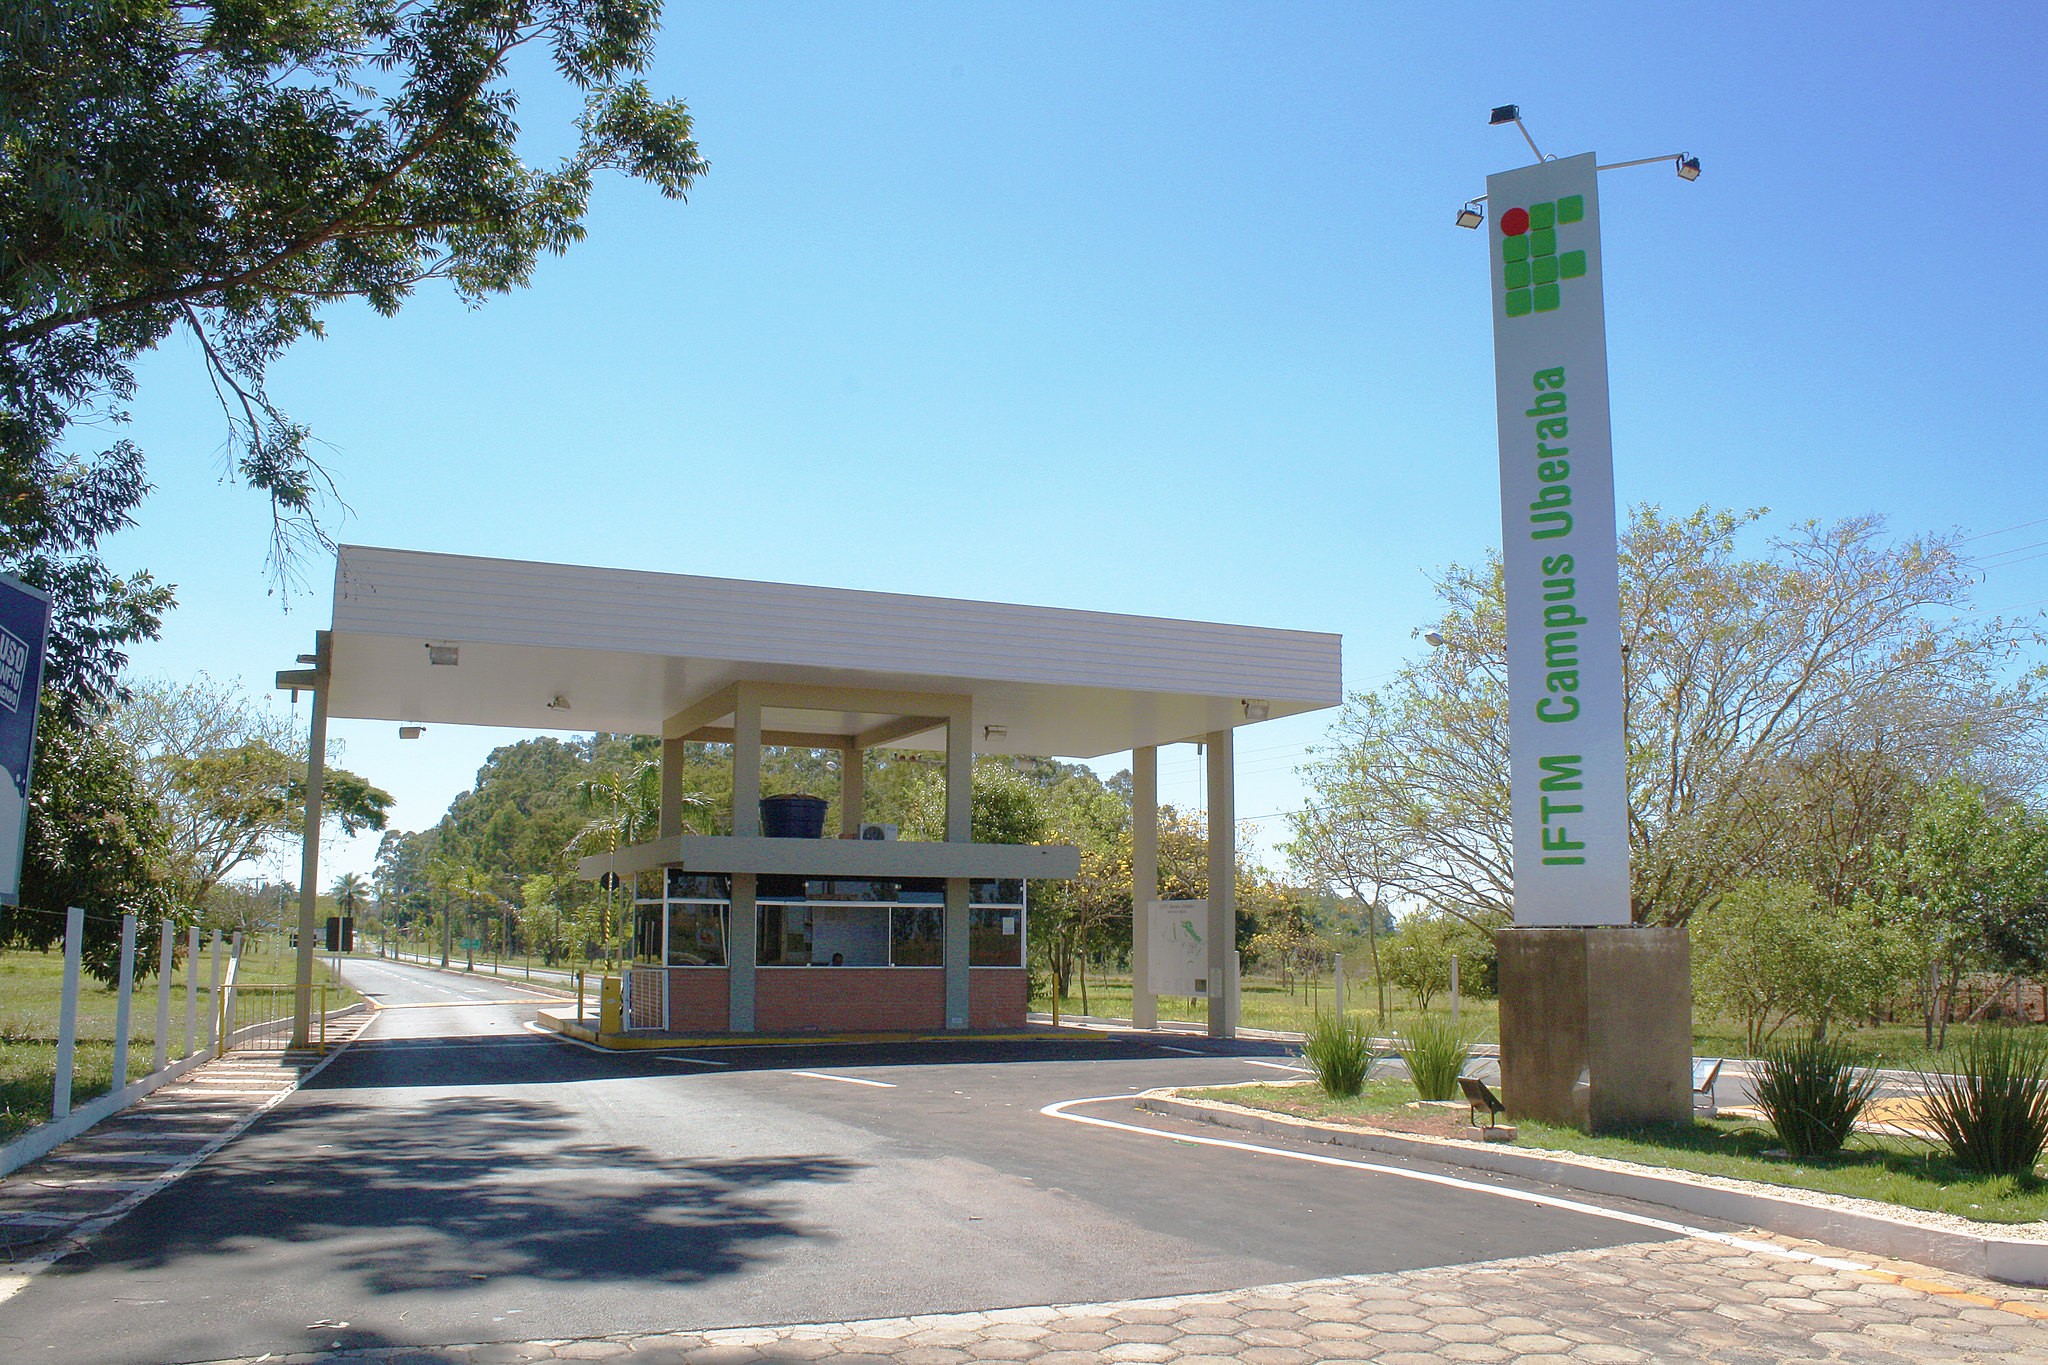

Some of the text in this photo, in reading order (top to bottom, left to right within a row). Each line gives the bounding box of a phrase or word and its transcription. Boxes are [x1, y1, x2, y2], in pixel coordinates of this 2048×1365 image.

[1525, 366, 1588, 867] IFTM Campus Uberaba
